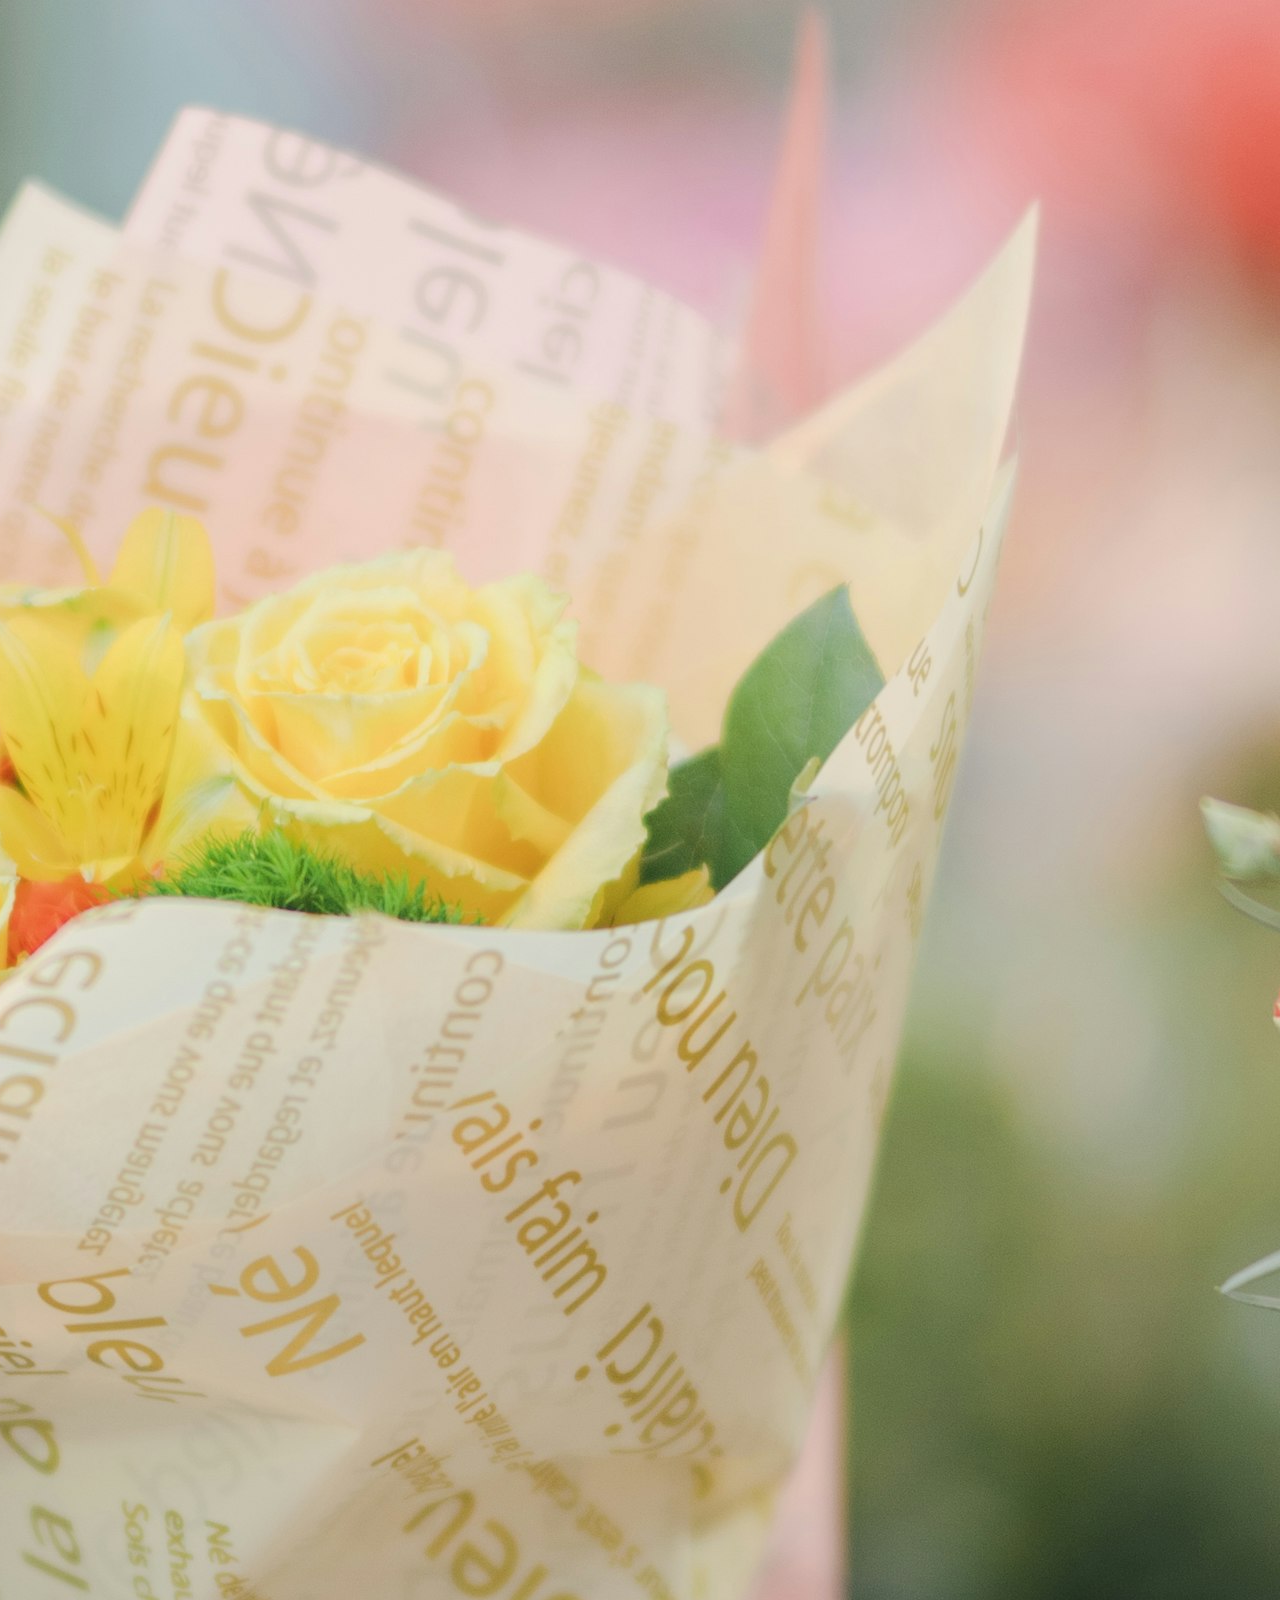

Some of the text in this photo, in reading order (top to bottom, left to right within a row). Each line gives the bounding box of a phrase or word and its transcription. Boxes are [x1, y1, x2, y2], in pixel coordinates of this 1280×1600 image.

[702, 1040, 798, 1232] Dieu
[330, 1200, 410, 1292] lequel
[505, 1170, 608, 1316] faim
[209, 1244, 368, 1378] Né
[392, 1278, 446, 1348] haut
[427, 1330, 464, 1372] en
[446, 1364, 490, 1414] l'air
[22, 1505, 91, 1593] la
[121, 1500, 152, 1574] Sois
